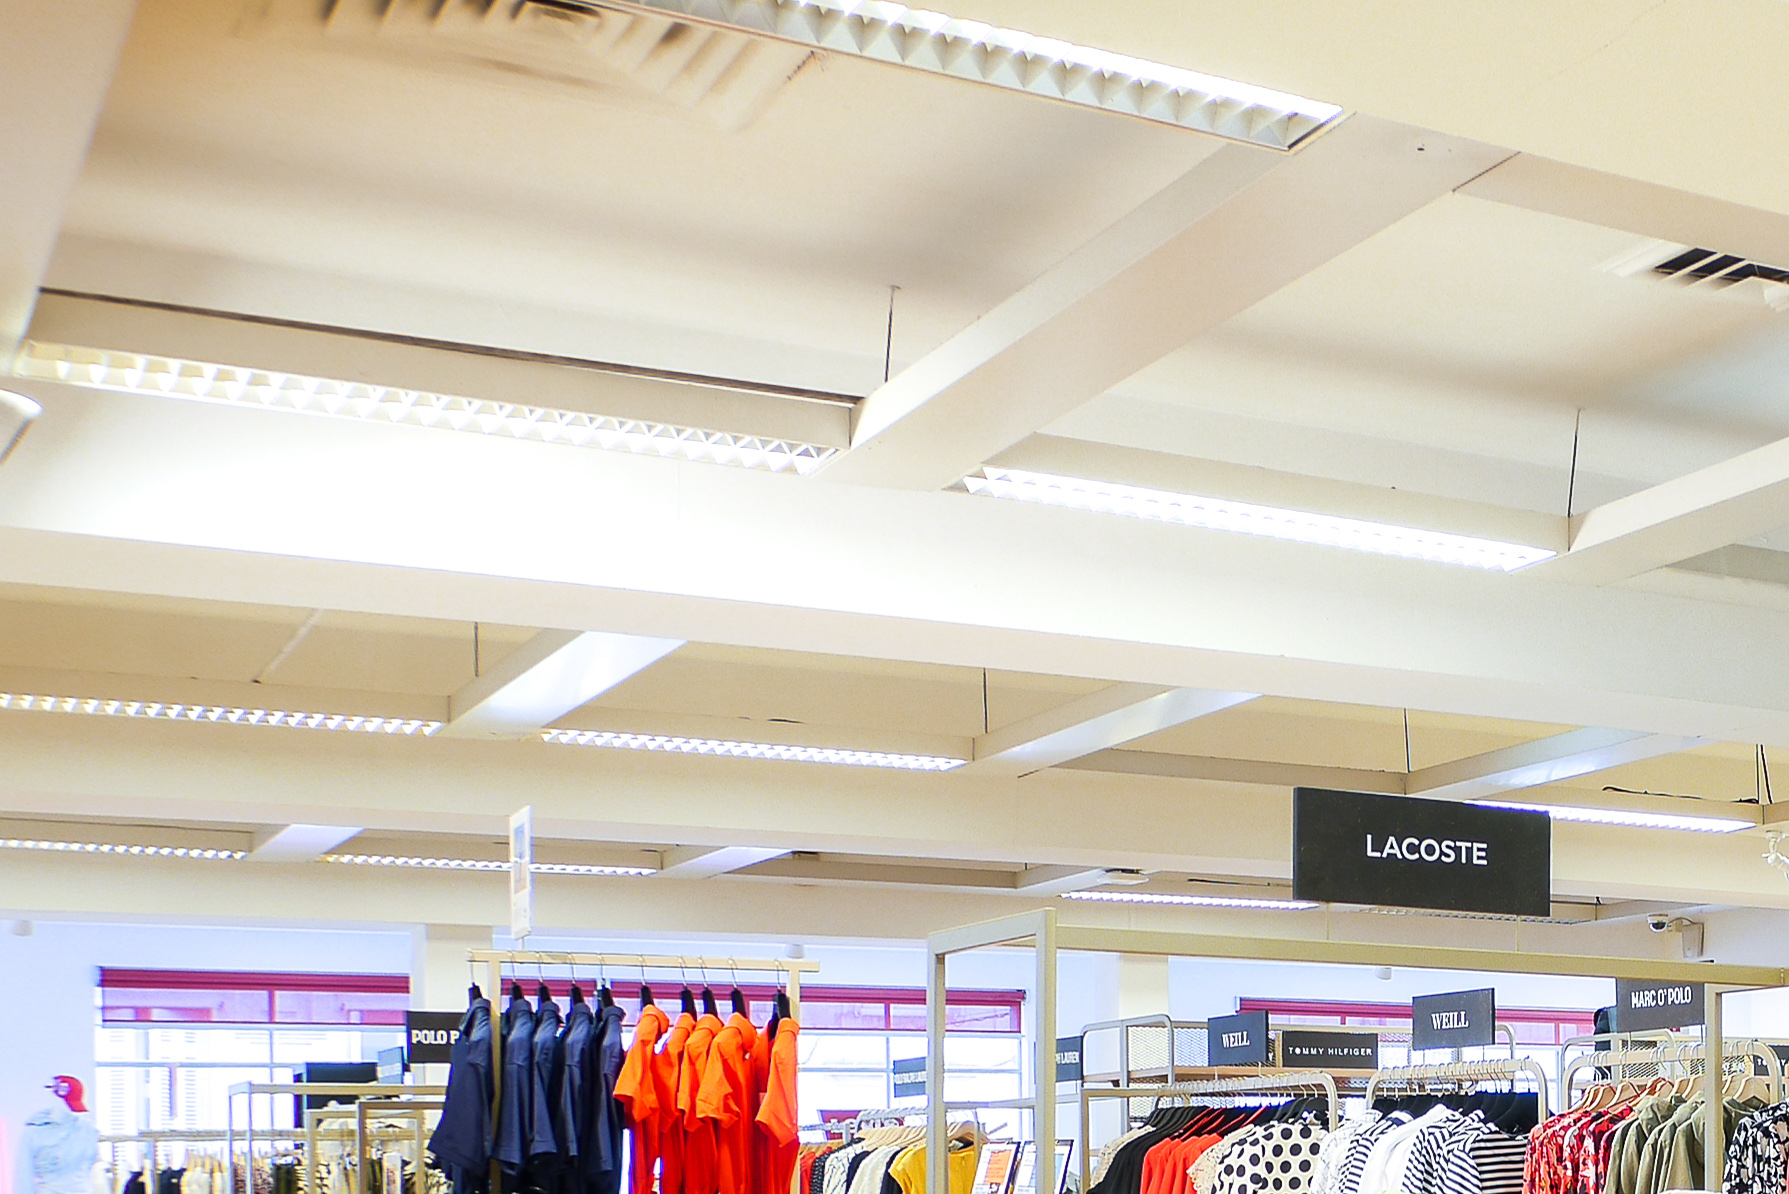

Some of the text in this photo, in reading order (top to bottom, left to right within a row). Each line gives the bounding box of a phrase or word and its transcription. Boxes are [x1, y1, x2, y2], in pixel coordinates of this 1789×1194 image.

[1365, 833, 1488, 866] LACOSTE
[1631, 989, 1657, 1009] MARC
[1667, 986, 1692, 1006] POLO
[1431, 1010, 1469, 1030] WEILL
[411, 1029, 448, 1045] POLO
[1221, 1030, 1251, 1048] WEILL
[1288, 1046, 1373, 1056] TOMMY HILFIGER
